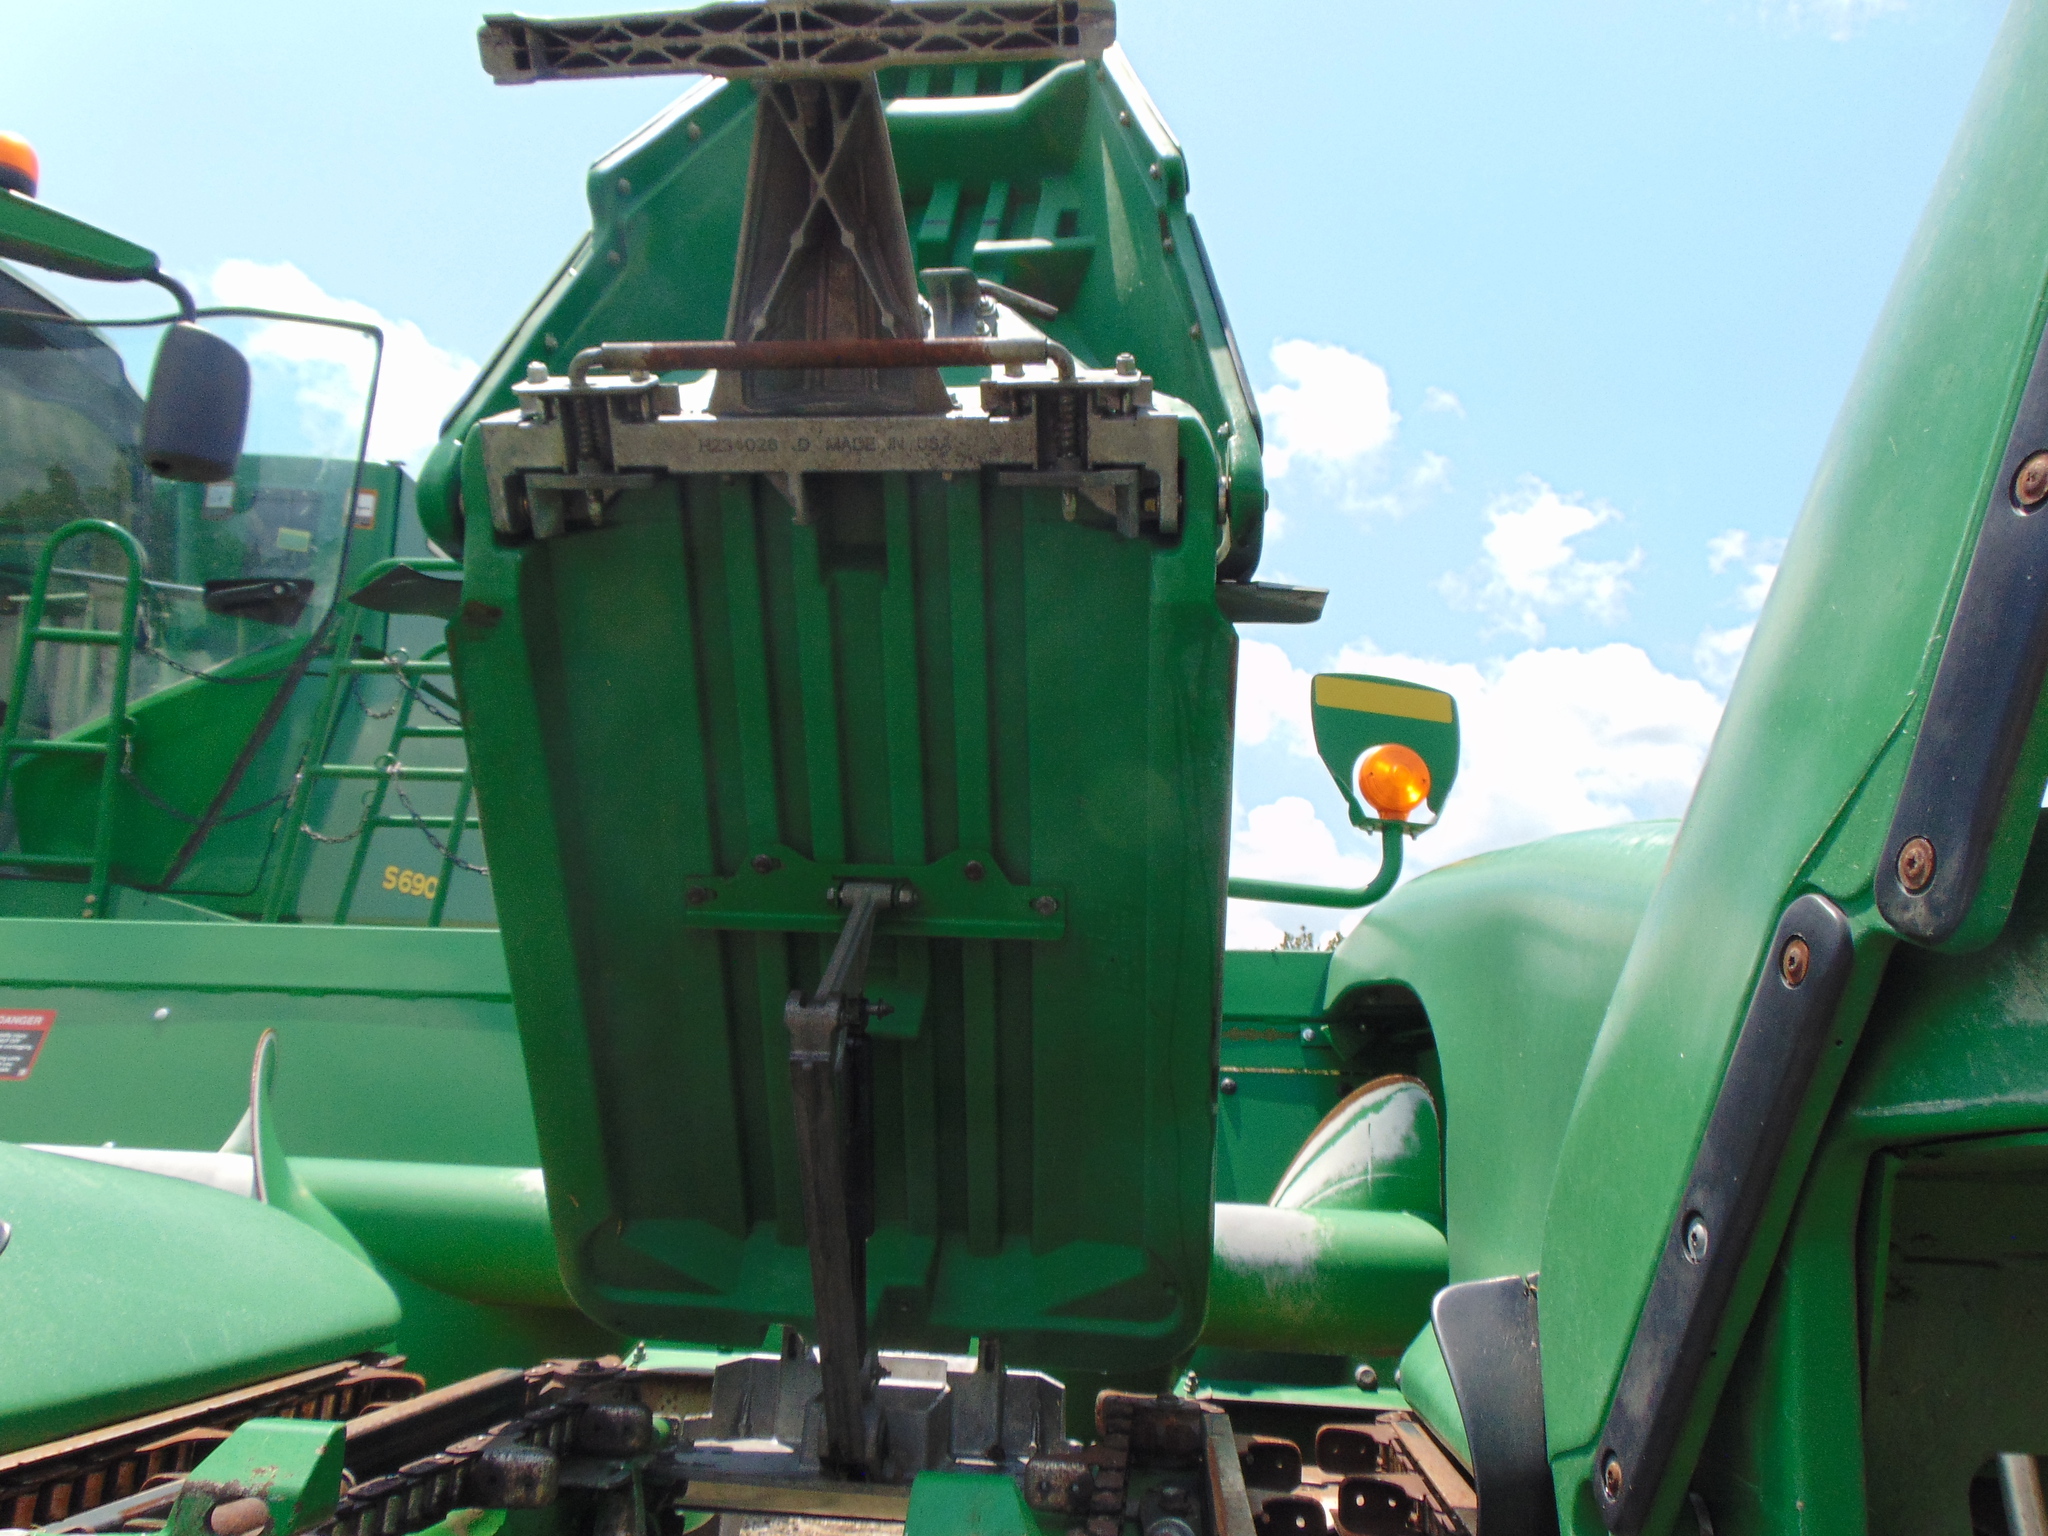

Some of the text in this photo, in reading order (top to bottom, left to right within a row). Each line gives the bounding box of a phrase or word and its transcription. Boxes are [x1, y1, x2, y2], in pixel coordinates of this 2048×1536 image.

[826, 436, 876, 452] MADE
[917, 436, 952, 452] USA
[382, 865, 439, 900] S690
